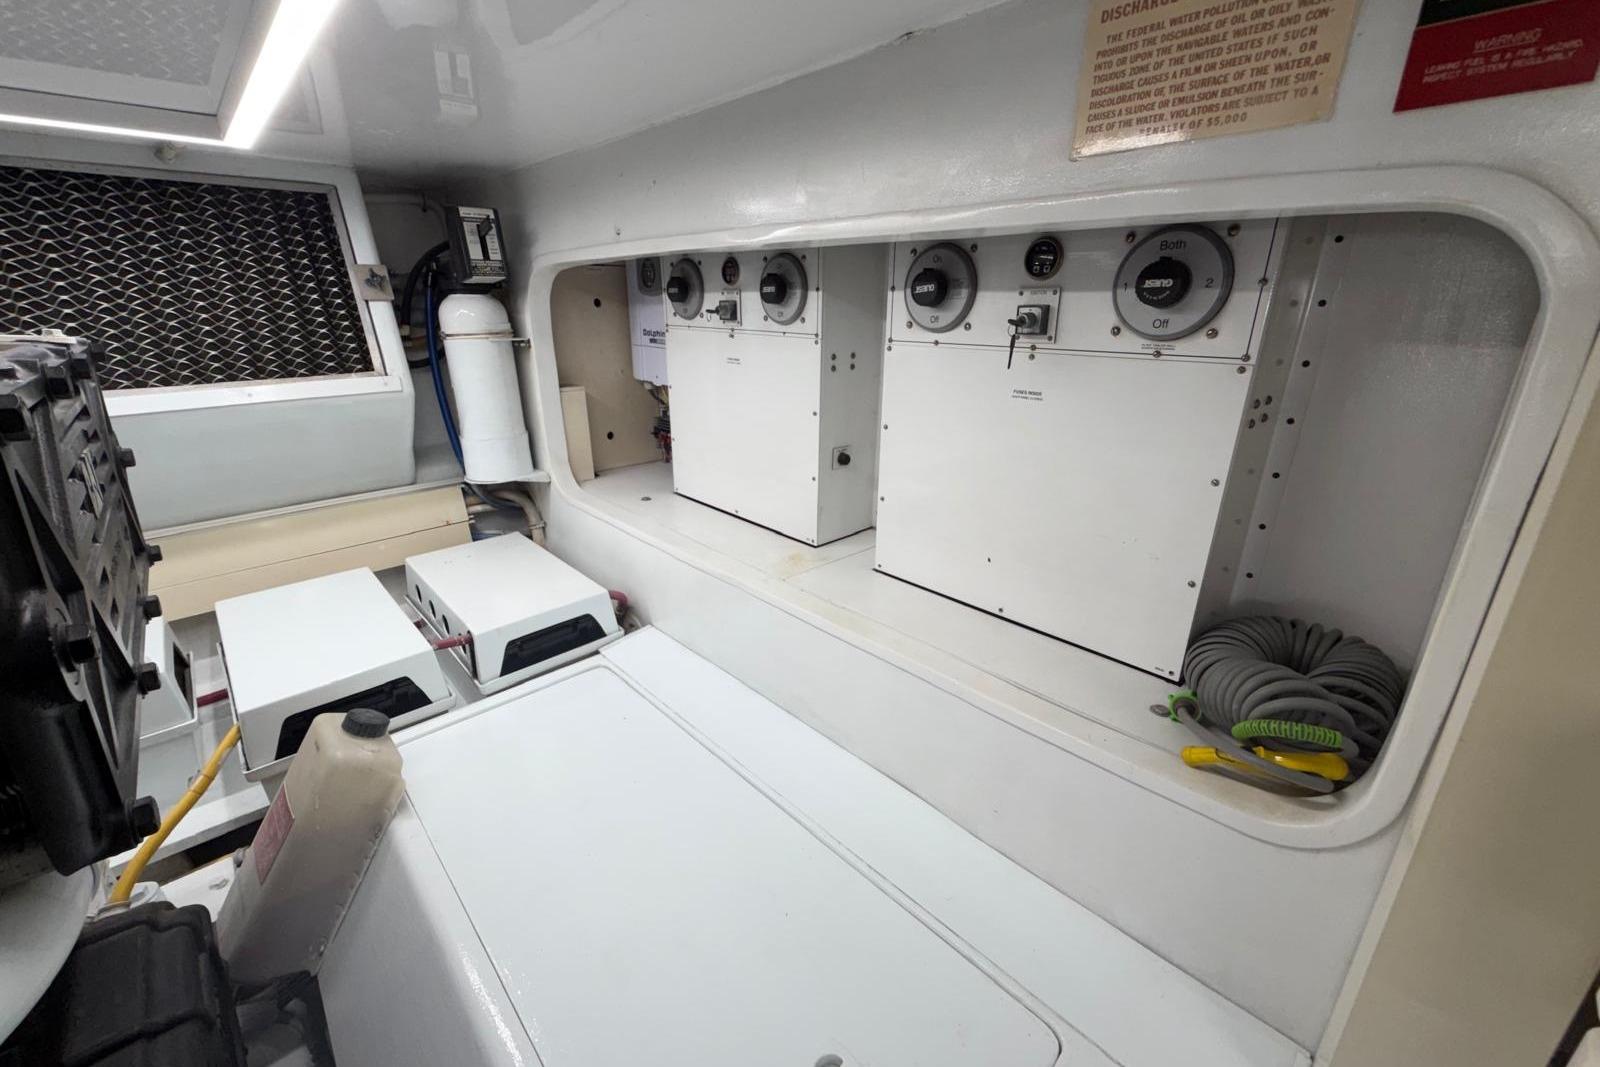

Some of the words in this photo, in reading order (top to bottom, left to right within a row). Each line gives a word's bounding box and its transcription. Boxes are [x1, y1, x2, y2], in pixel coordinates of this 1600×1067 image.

[1094, 61, 1113, 72] INTO
[1116, 57, 1127, 68] OR
[1129, 51, 1153, 64] UPON
[1156, 45, 1173, 57] THE
[1176, 31, 1228, 52] NAVIGABLE
[1232, 20, 1274, 39] WATERS
[1278, 14, 1301, 28] AND
[1305, 7, 1335, 21] CON-
[1096, 41, 1138, 60] PROHIBITS
[1142, 36, 1157, 48] THE
[1160, 22, 1212, 43] DISCHARGE
[1215, 18, 1229, 29] OF
[1230, 13, 1246, 26] OIL
[1250, 8, 1265, 20] OR
[1268, 2, 1292, 17] OILY
[1106, 32, 1123, 44] THE
[1126, 21, 1166, 39] FEDERAL
[1169, 11, 1201, 27] WATER
[1474, 28, 1543, 50] WARNING
[1091, 80, 1135, 98] DISCHARGE
[1137, 72, 1169, 87] CAUSES
[1171, 71, 1178, 80] A
[1179, 65, 1201, 78] FILM
[1204, 62, 1217, 73] OR
[1219, 55, 1251, 70] SHEEN
[1299, 40, 1318, 53] OR
[1093, 69, 1126, 84] TIGUOUS
[1129, 64, 1151, 77] ZONE
[1153, 61, 1164, 72] OF
[1168, 55, 1186, 67] THE
[1189, 47, 1223, 61] UNITED
[1226, 37, 1264, 55] STATES
[1267, 33, 1279, 45] IF
[1283, 25, 1318, 42] SUCH
[1085, 123, 1104, 134] FACE
[1105, 121, 1117, 132] OF
[1118, 119, 1133, 129] THE
[1170, 104, 1220, 119] VIOLATORS
[1222, 99, 1241, 111] ARE
[1243, 90, 1288, 107] SUBJECT
[1293, 87, 1308, 98] TO
[1311, 85, 1319, 96] A
[1087, 109, 1116, 123] CAUSES
[1117, 108, 1123, 117] A
[1125, 101, 1156, 115] SLUDGE
[1158, 99, 1170, 109] OR
[1172, 90, 1218, 106] EMULSION
[1220, 80, 1266, 98] BENEATH
[1270, 75, 1291, 89] THE
[1294, 70, 1324, 83] SUR-
[1089, 89, 1151, 110] DISCOLORATION
[1169, 82, 1185, 94] THE
[1188, 73, 1230, 90] SURFACE
[1233, 69, 1246, 81] OF
[1250, 64, 1270, 78] THE
[1189, 118, 1204, 129] OF
[1160, 240, 1187, 251] Both
[1205, 278, 1214, 289] 2
[1153, 318, 1169, 329] Off
